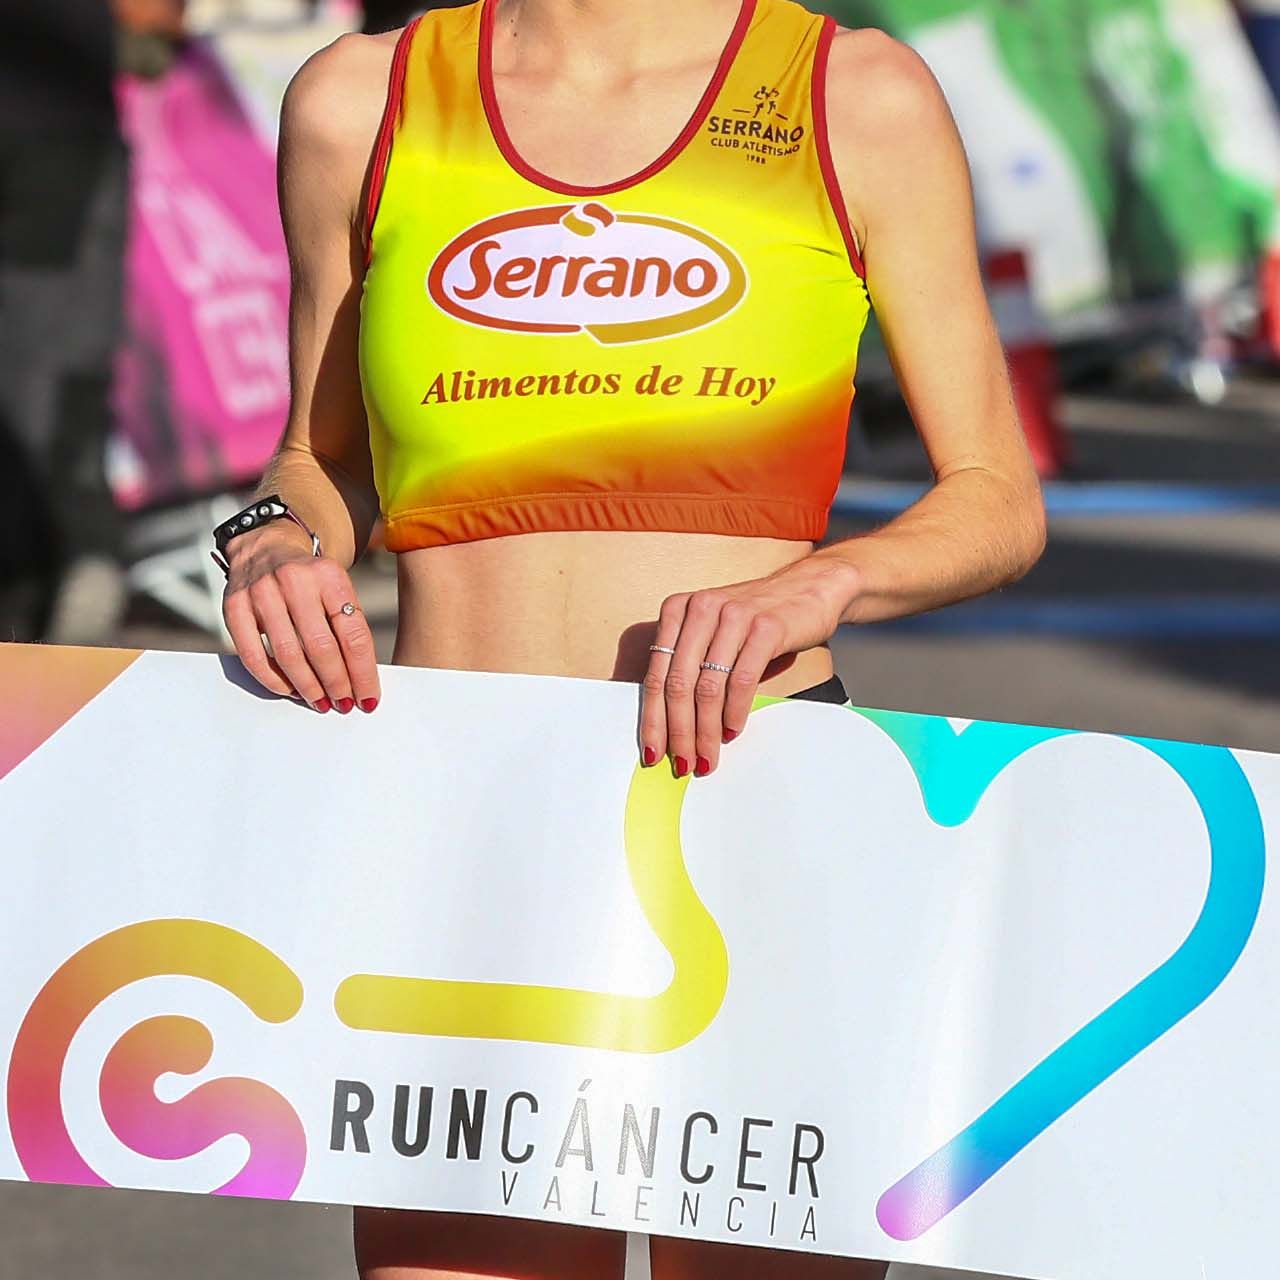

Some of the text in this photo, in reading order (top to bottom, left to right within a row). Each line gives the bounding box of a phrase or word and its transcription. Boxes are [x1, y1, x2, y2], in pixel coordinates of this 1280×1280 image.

[707, 115, 805, 145] SERRANO
[710, 137, 800, 157] CLUB ATLETISMO
[452, 240, 718, 301] Serrano
[421, 364, 776, 406] Alimentos de Hoy
[330, 1078, 824, 1198] RUNCÁNCER
[502, 1170, 818, 1241] VALENCIA
